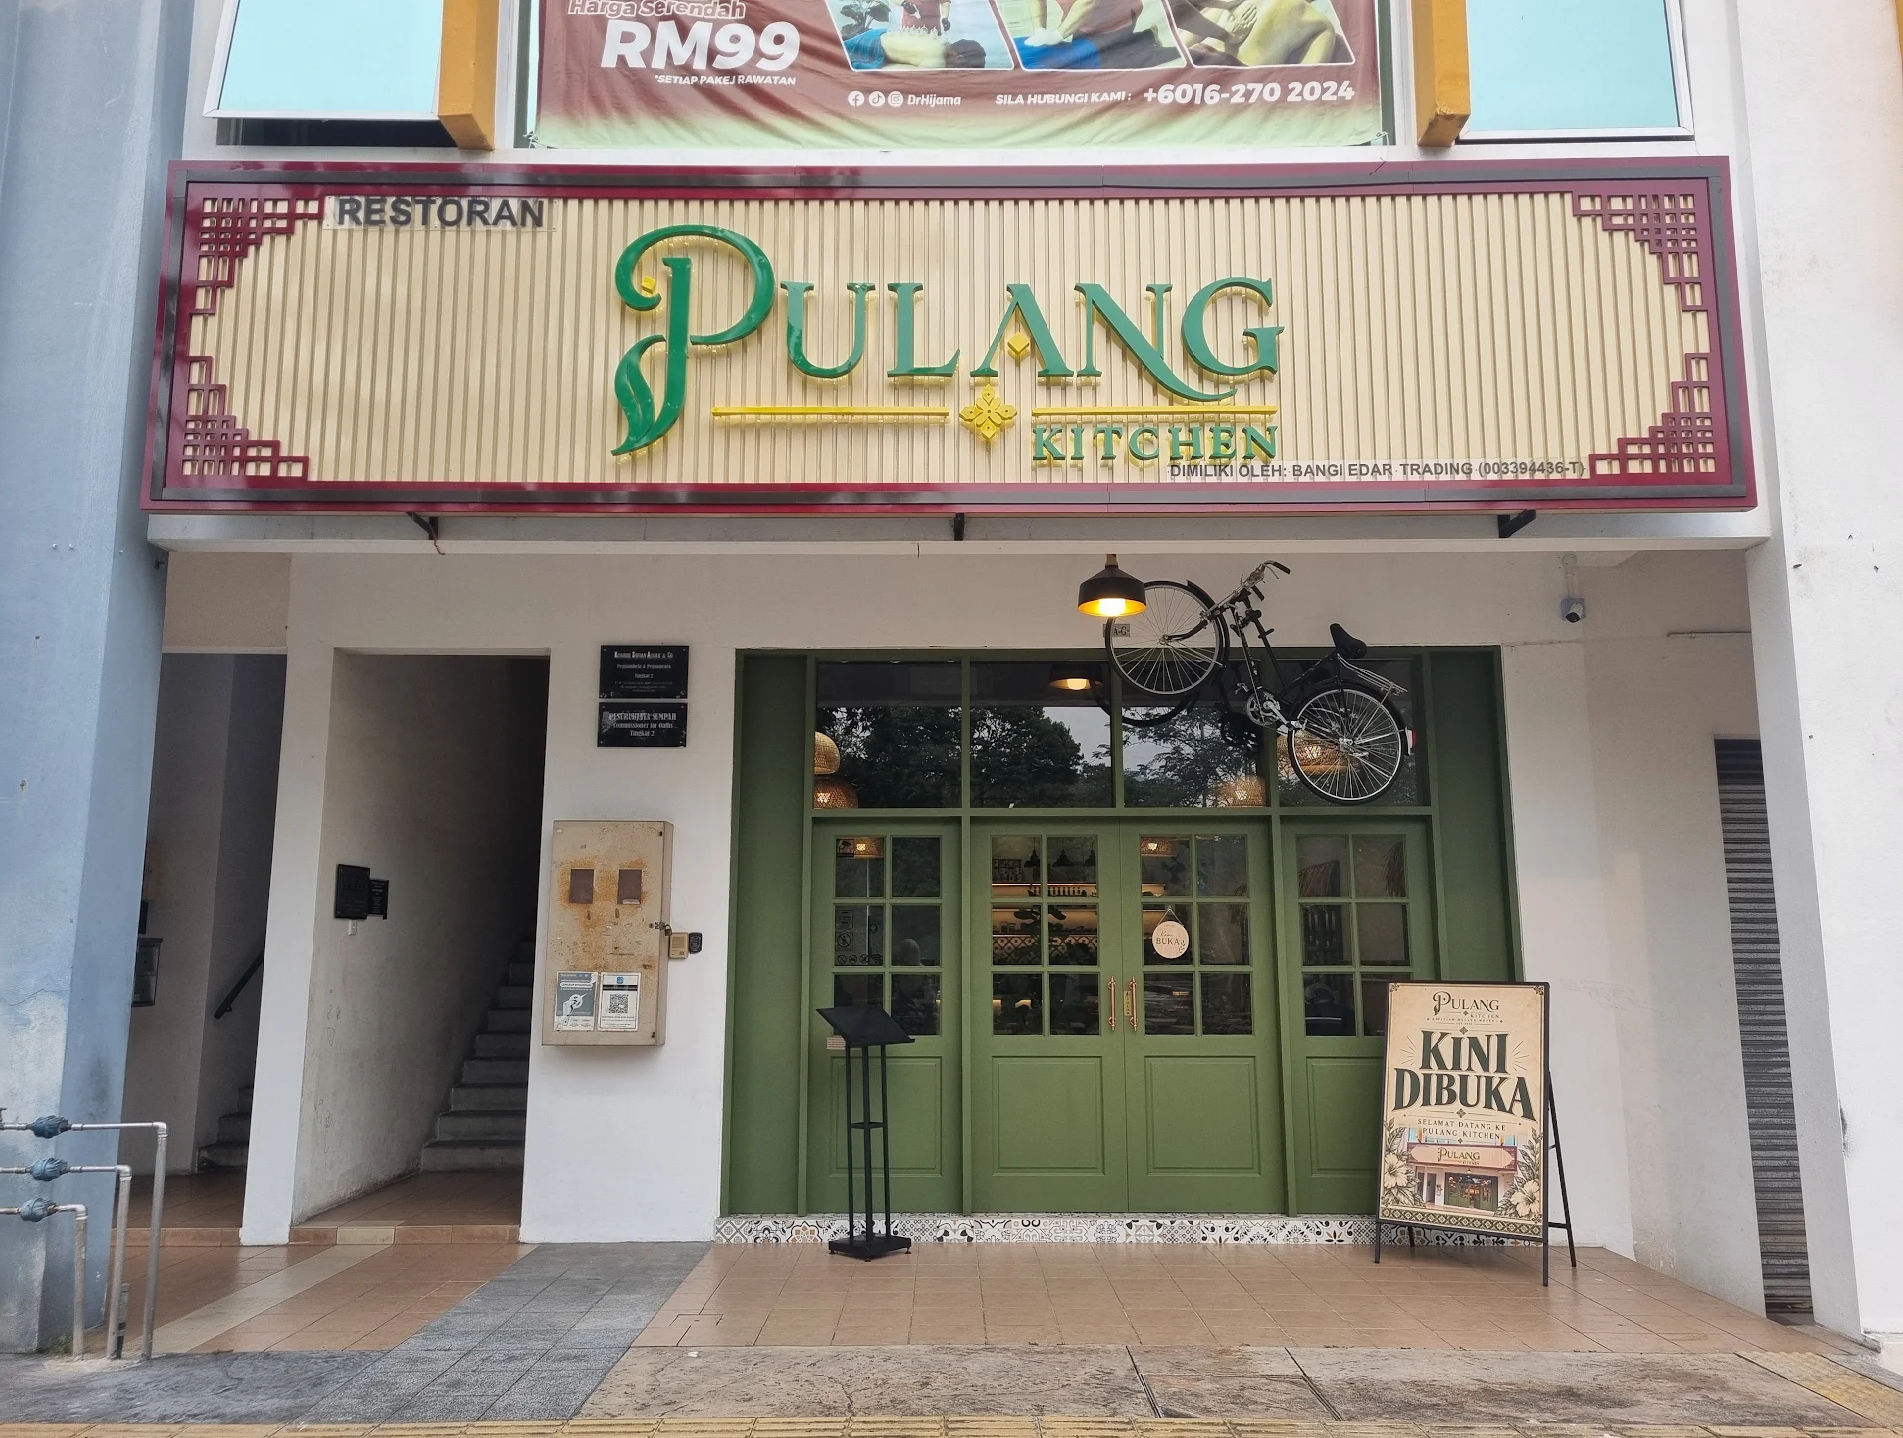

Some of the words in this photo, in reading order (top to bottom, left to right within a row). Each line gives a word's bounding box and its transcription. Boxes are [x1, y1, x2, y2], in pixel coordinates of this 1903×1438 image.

[568, 0, 637, 18] Harga
[638, 0, 746, 19] Serendah
[601, 19, 800, 71] RM99
[700, 75, 736, 85] PAKEJ
[737, 74, 797, 86] RAWATAN
[907, 94, 962, 107] DrHijama
[996, 94, 1024, 105] SILA
[1027, 93, 1089, 105] HUBUNGI
[1143, 82, 1282, 105] +6016-270
[1286, 80, 1355, 102] 2024
[337, 198, 544, 228] RESTORAN
[611, 223, 1285, 457] PULANG
[1032, 425, 1279, 464] KITCHEN
[1170, 464, 1234, 478] DIMILIKI
[1238, 463, 1287, 478] OLEH:
[1291, 463, 1343, 477] BANGI
[1348, 463, 1393, 477] EDAR
[1399, 462, 1473, 476] TRADING
[1478, 461, 1586, 478] (003394436-T)
[1156, 937, 1180, 945] BUKA
[1432, 990, 1500, 1016] PULANG
[1418, 1030, 1511, 1075] KINI
[1392, 1067, 1538, 1122] DIBUKA
[1417, 1118, 1455, 1128] SELAMAT
[1458, 1121, 1492, 1130] DATANG
[1495, 1124, 1506, 1132] KE
[1422, 1127, 1458, 1137] PULANG
[1462, 1130, 1501, 1140] KITCHEN
[1437, 1146, 1481, 1163] PULANG
